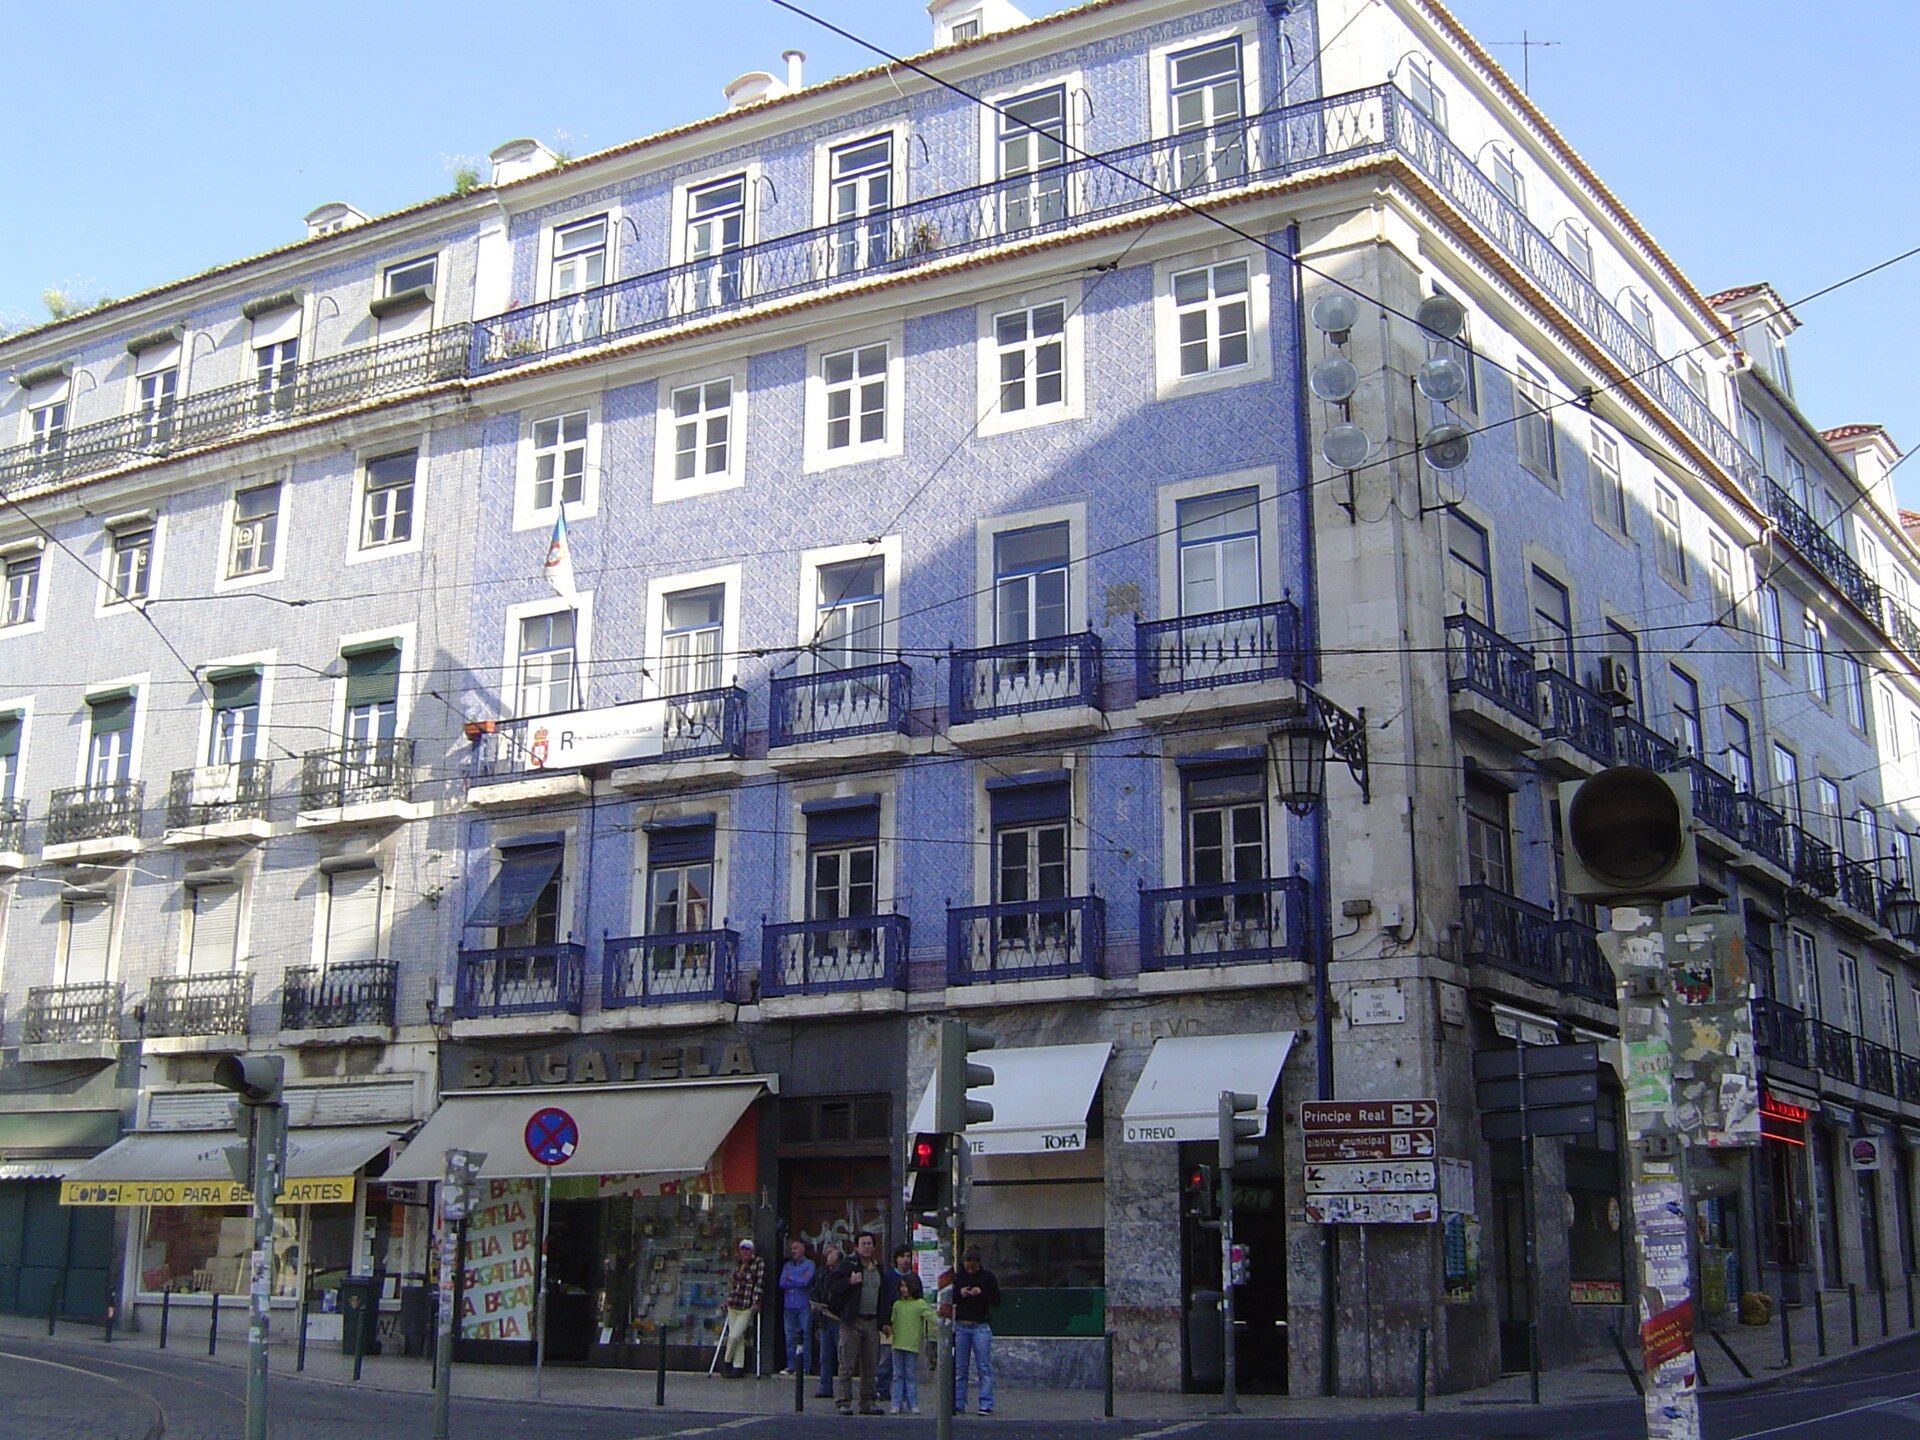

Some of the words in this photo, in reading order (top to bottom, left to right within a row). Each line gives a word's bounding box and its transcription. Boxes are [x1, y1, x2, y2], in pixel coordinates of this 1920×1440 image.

[463, 1044, 757, 1087] BAGATELA
[1358, 1109, 1385, 1121] Real
[1042, 1133, 1080, 1149] TOFA
[1127, 1128, 1136, 1140] O
[1139, 1127, 1176, 1139] TREVO
[1342, 1134, 1386, 1148] municipal
[68, 1184, 123, 1202] Corbel
[137, 1187, 175, 1203] TUDO
[182, 1186, 221, 1202] PARA
[230, 1185, 256, 1201] BEL
[289, 1183, 343, 1201] ARTES
